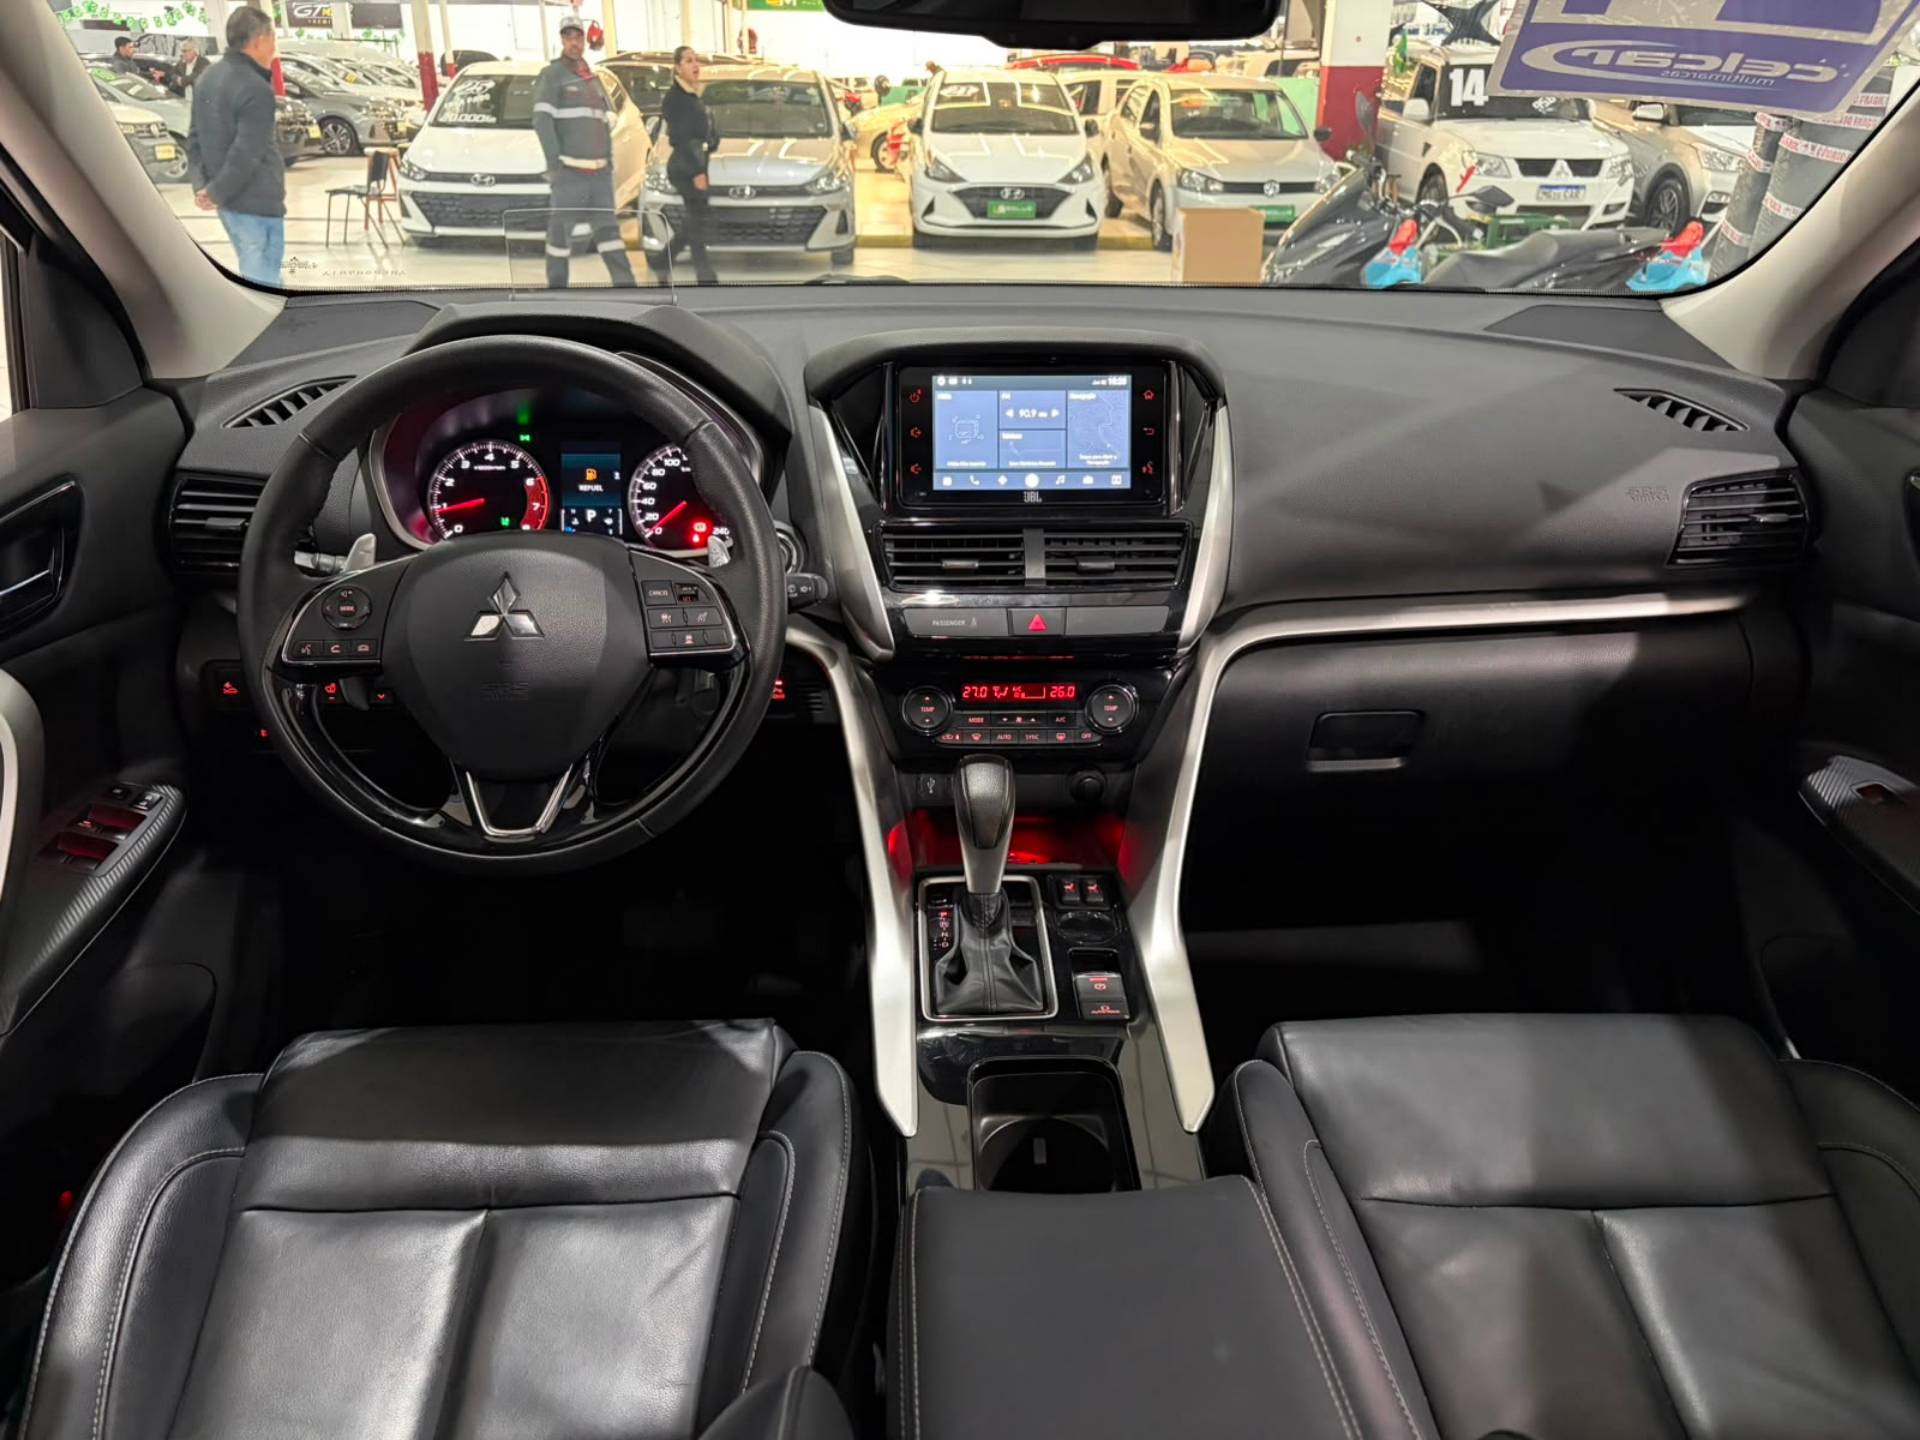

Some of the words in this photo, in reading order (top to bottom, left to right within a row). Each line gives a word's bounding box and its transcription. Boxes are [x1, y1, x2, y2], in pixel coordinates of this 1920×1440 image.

[1450, 69, 1489, 106] 14
[484, 453, 496, 462] 4
[460, 460, 471, 470] 3
[510, 460, 520, 470] 5
[664, 458, 681, 467] 100
[651, 468, 666, 477] 80
[444, 478, 455, 487] 2
[525, 478, 535, 487] 6
[642, 482, 657, 491] 60
[578, 484, 604, 492] REFUEL
[1024, 490, 1043, 503] JBL
[641, 497, 656, 506] 40
[532, 502, 540, 511] 7
[586, 509, 597, 523] P
[453, 524, 463, 534] 0
[931, 619, 966, 627] PASSENGER
[962, 685, 988, 699] 27.0
[1050, 685, 1076, 699] 26.0
[996, 733, 1012, 741] AUTO
